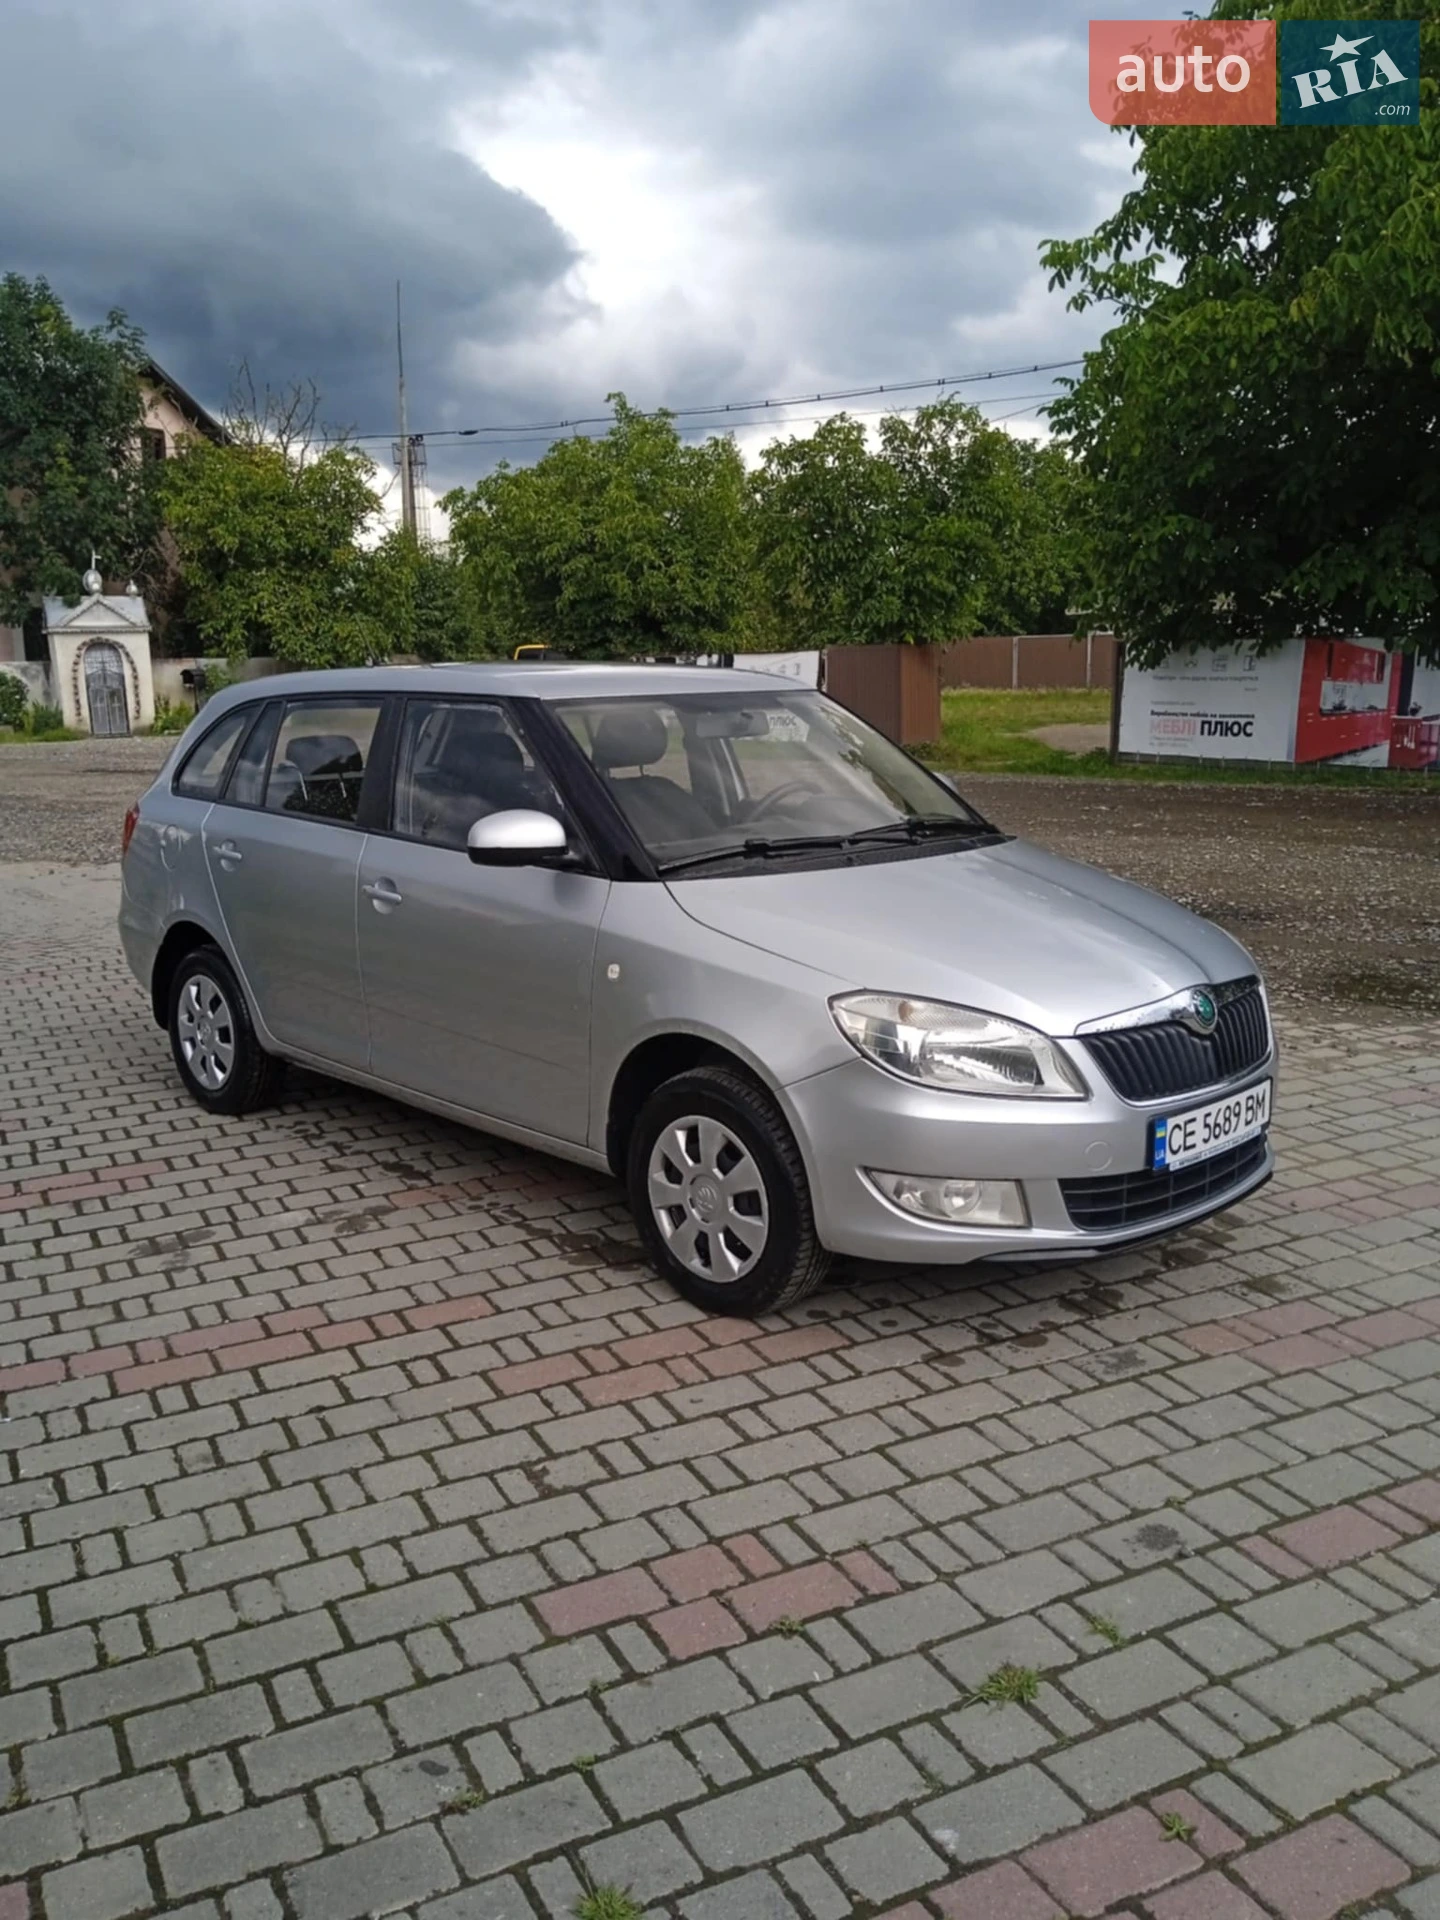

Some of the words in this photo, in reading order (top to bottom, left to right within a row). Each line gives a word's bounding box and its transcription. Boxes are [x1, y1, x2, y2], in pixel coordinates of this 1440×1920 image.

[1150, 719, 1196, 736] МЕБЛІ
[1200, 720, 1254, 738] ПЛЮС
[1168, 1117, 1197, 1155] CE
[1202, 1101, 1241, 1144] 5689
[1245, 1089, 1266, 1127] BM
